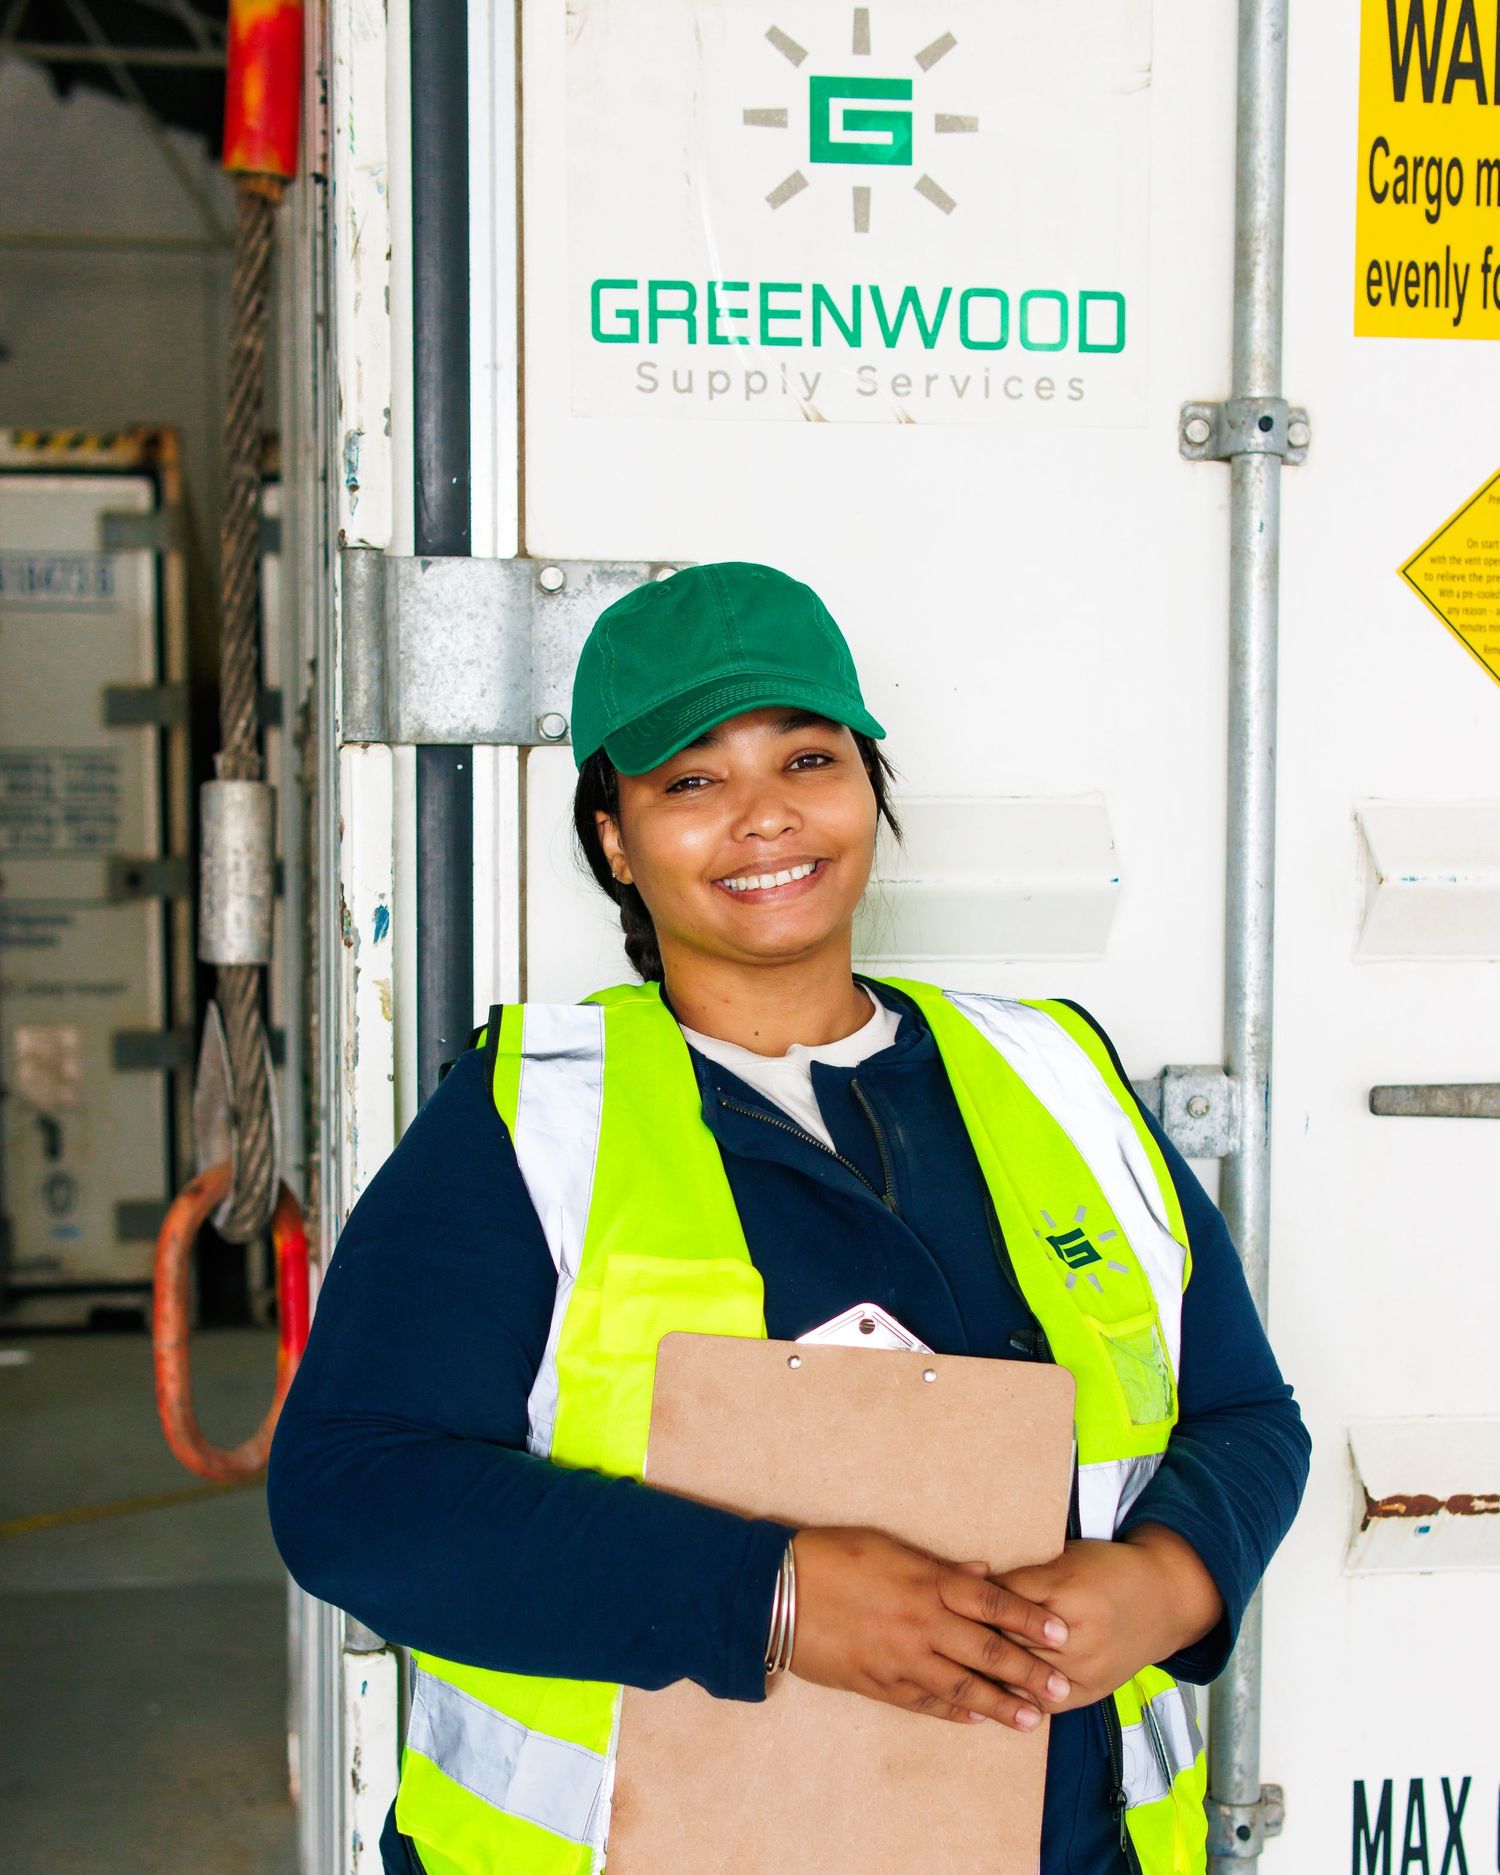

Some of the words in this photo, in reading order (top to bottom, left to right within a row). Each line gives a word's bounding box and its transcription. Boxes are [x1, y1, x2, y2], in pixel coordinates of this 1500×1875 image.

[1386, 0, 1500, 105] WA
[1369, 136, 1464, 224] Cargo
[1366, 245, 1470, 327] evenly
[590, 279, 1127, 354] GREENWOOD
[636, 361, 822, 400] Supply
[856, 365, 1085, 401] Services
[1430, 554, 1447, 564] with
[1449, 555, 1462, 565] the
[1467, 537, 1479, 549] On
[1424, 572, 1434, 581] to
[1436, 571, 1466, 582] relieve
[1469, 572, 1483, 582] the
[1439, 587, 1454, 597] With
[1462, 607, 1487, 616] reason
[1352, 1776, 1472, 1875] MAX
